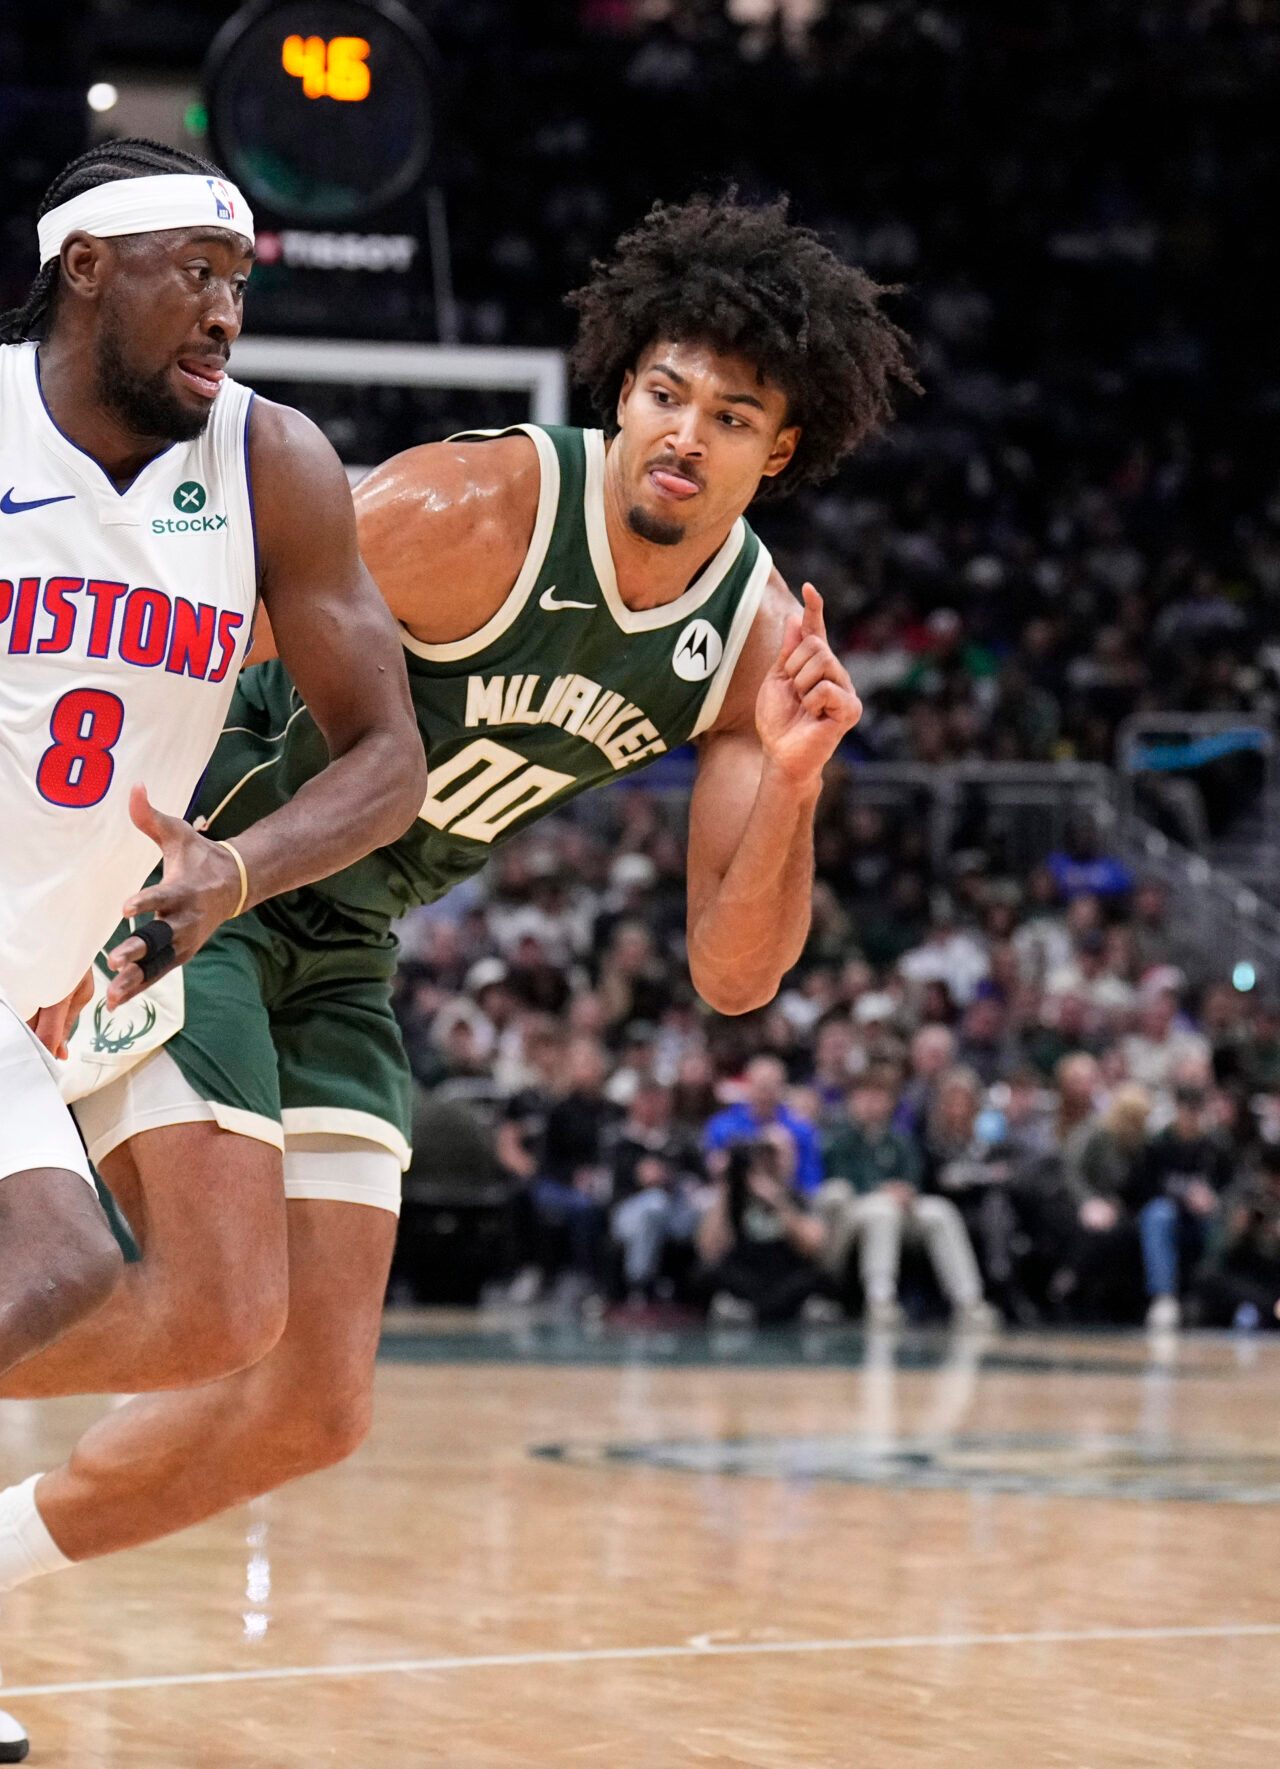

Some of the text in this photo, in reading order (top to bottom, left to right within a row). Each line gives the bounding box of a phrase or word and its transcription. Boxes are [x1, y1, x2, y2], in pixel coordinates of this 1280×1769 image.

[152, 514, 228, 534] StockX
[36, 687, 125, 809] 8
[417, 737, 577, 843] 00
